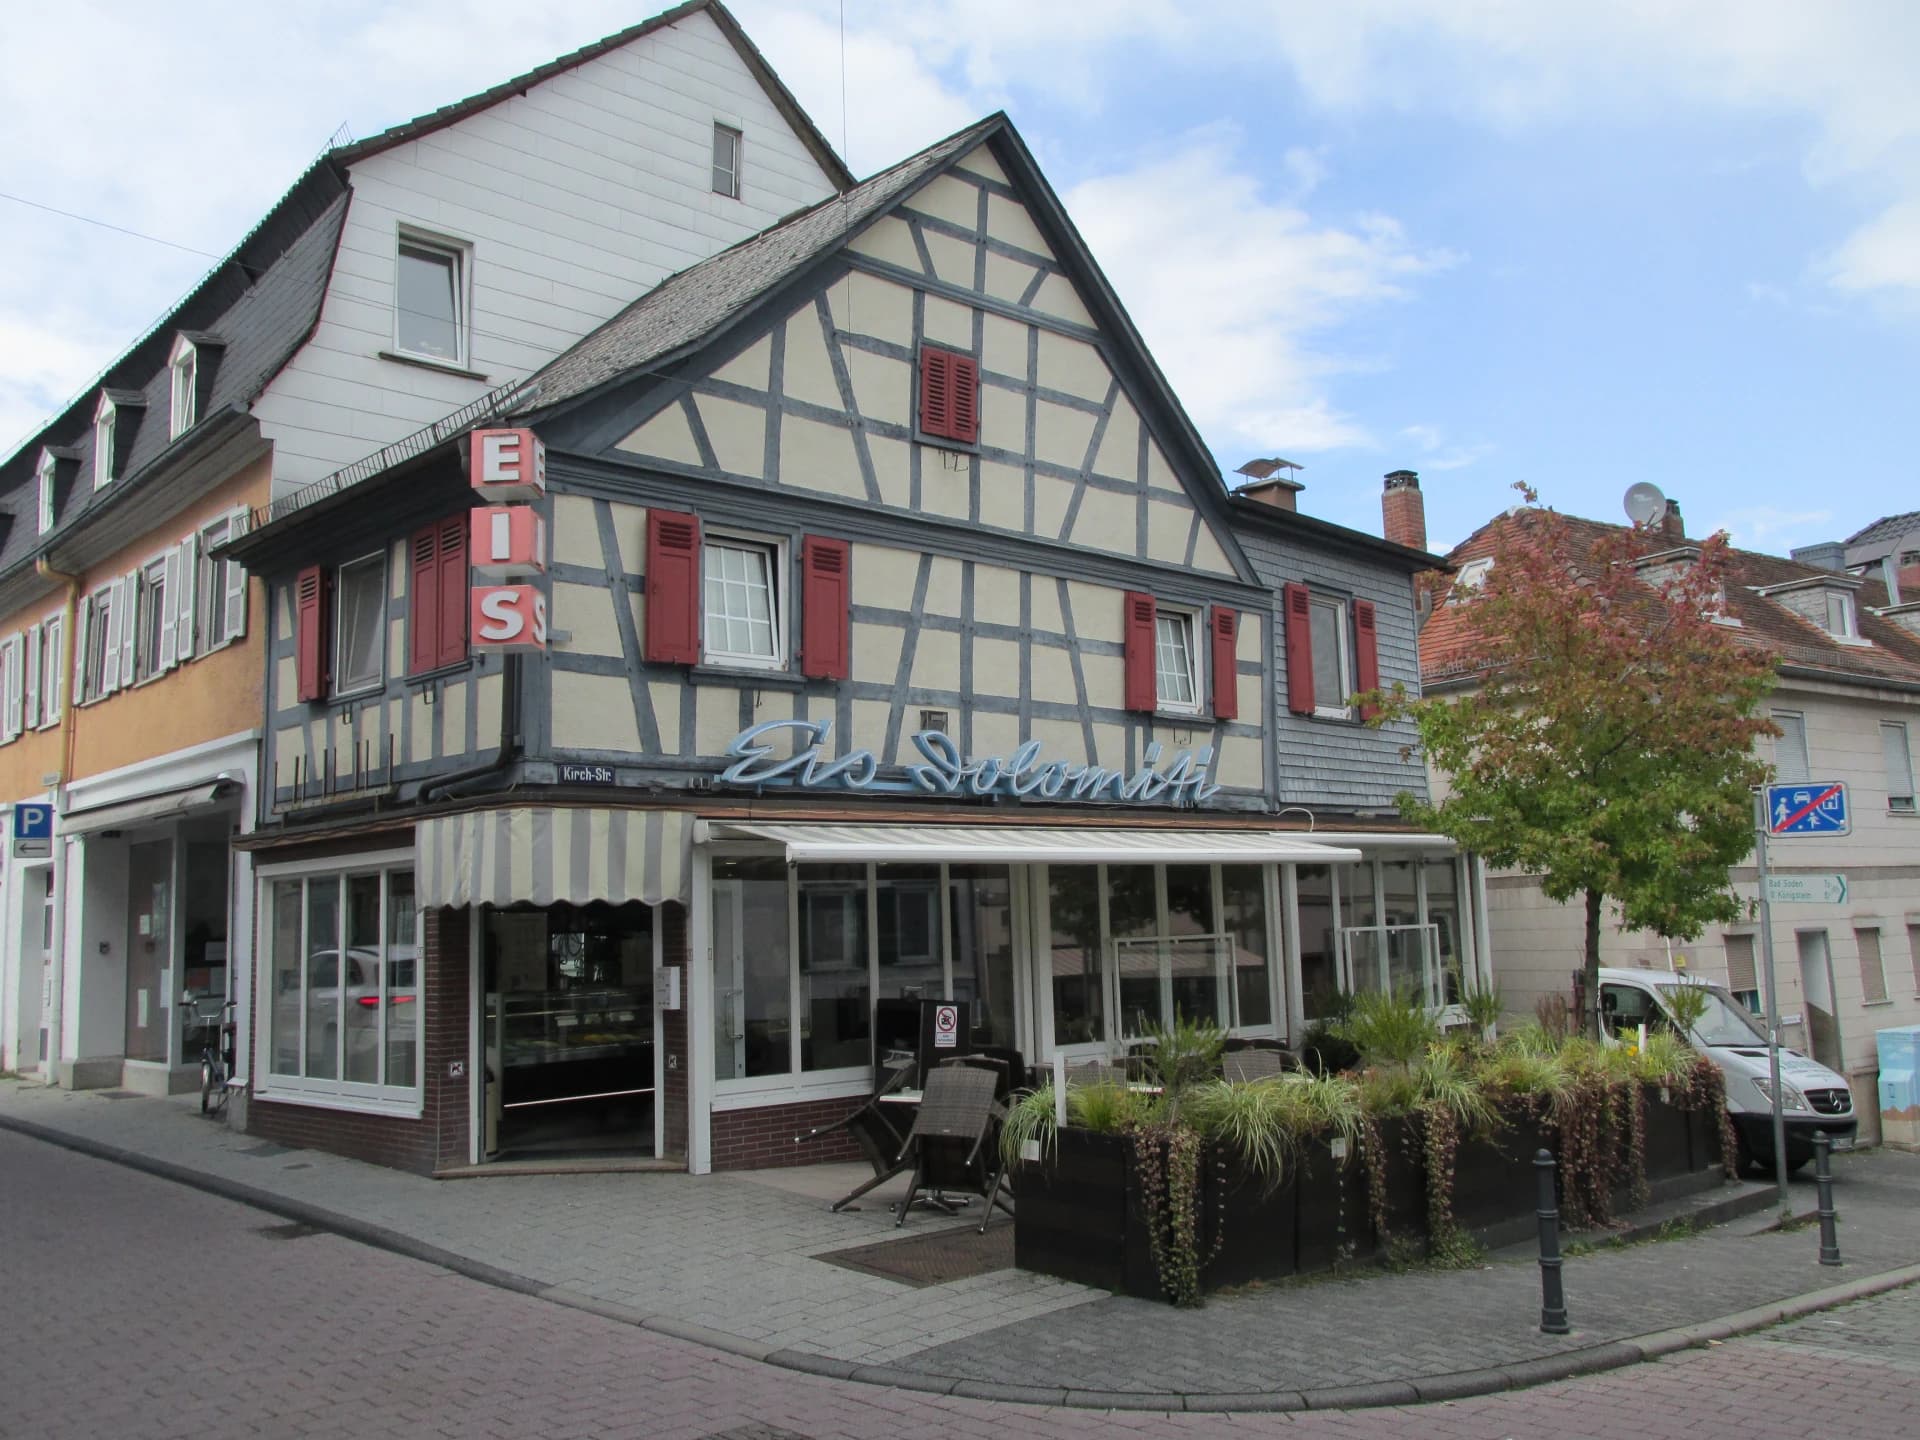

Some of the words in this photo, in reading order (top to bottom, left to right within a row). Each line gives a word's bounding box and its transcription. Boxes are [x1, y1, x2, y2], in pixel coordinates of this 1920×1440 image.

[721, 720, 877, 787] Eis
[905, 731, 1222, 799] Dolomiti
[563, 766, 612, 782] Kirch-Str.
[23, 808, 44, 834] P
